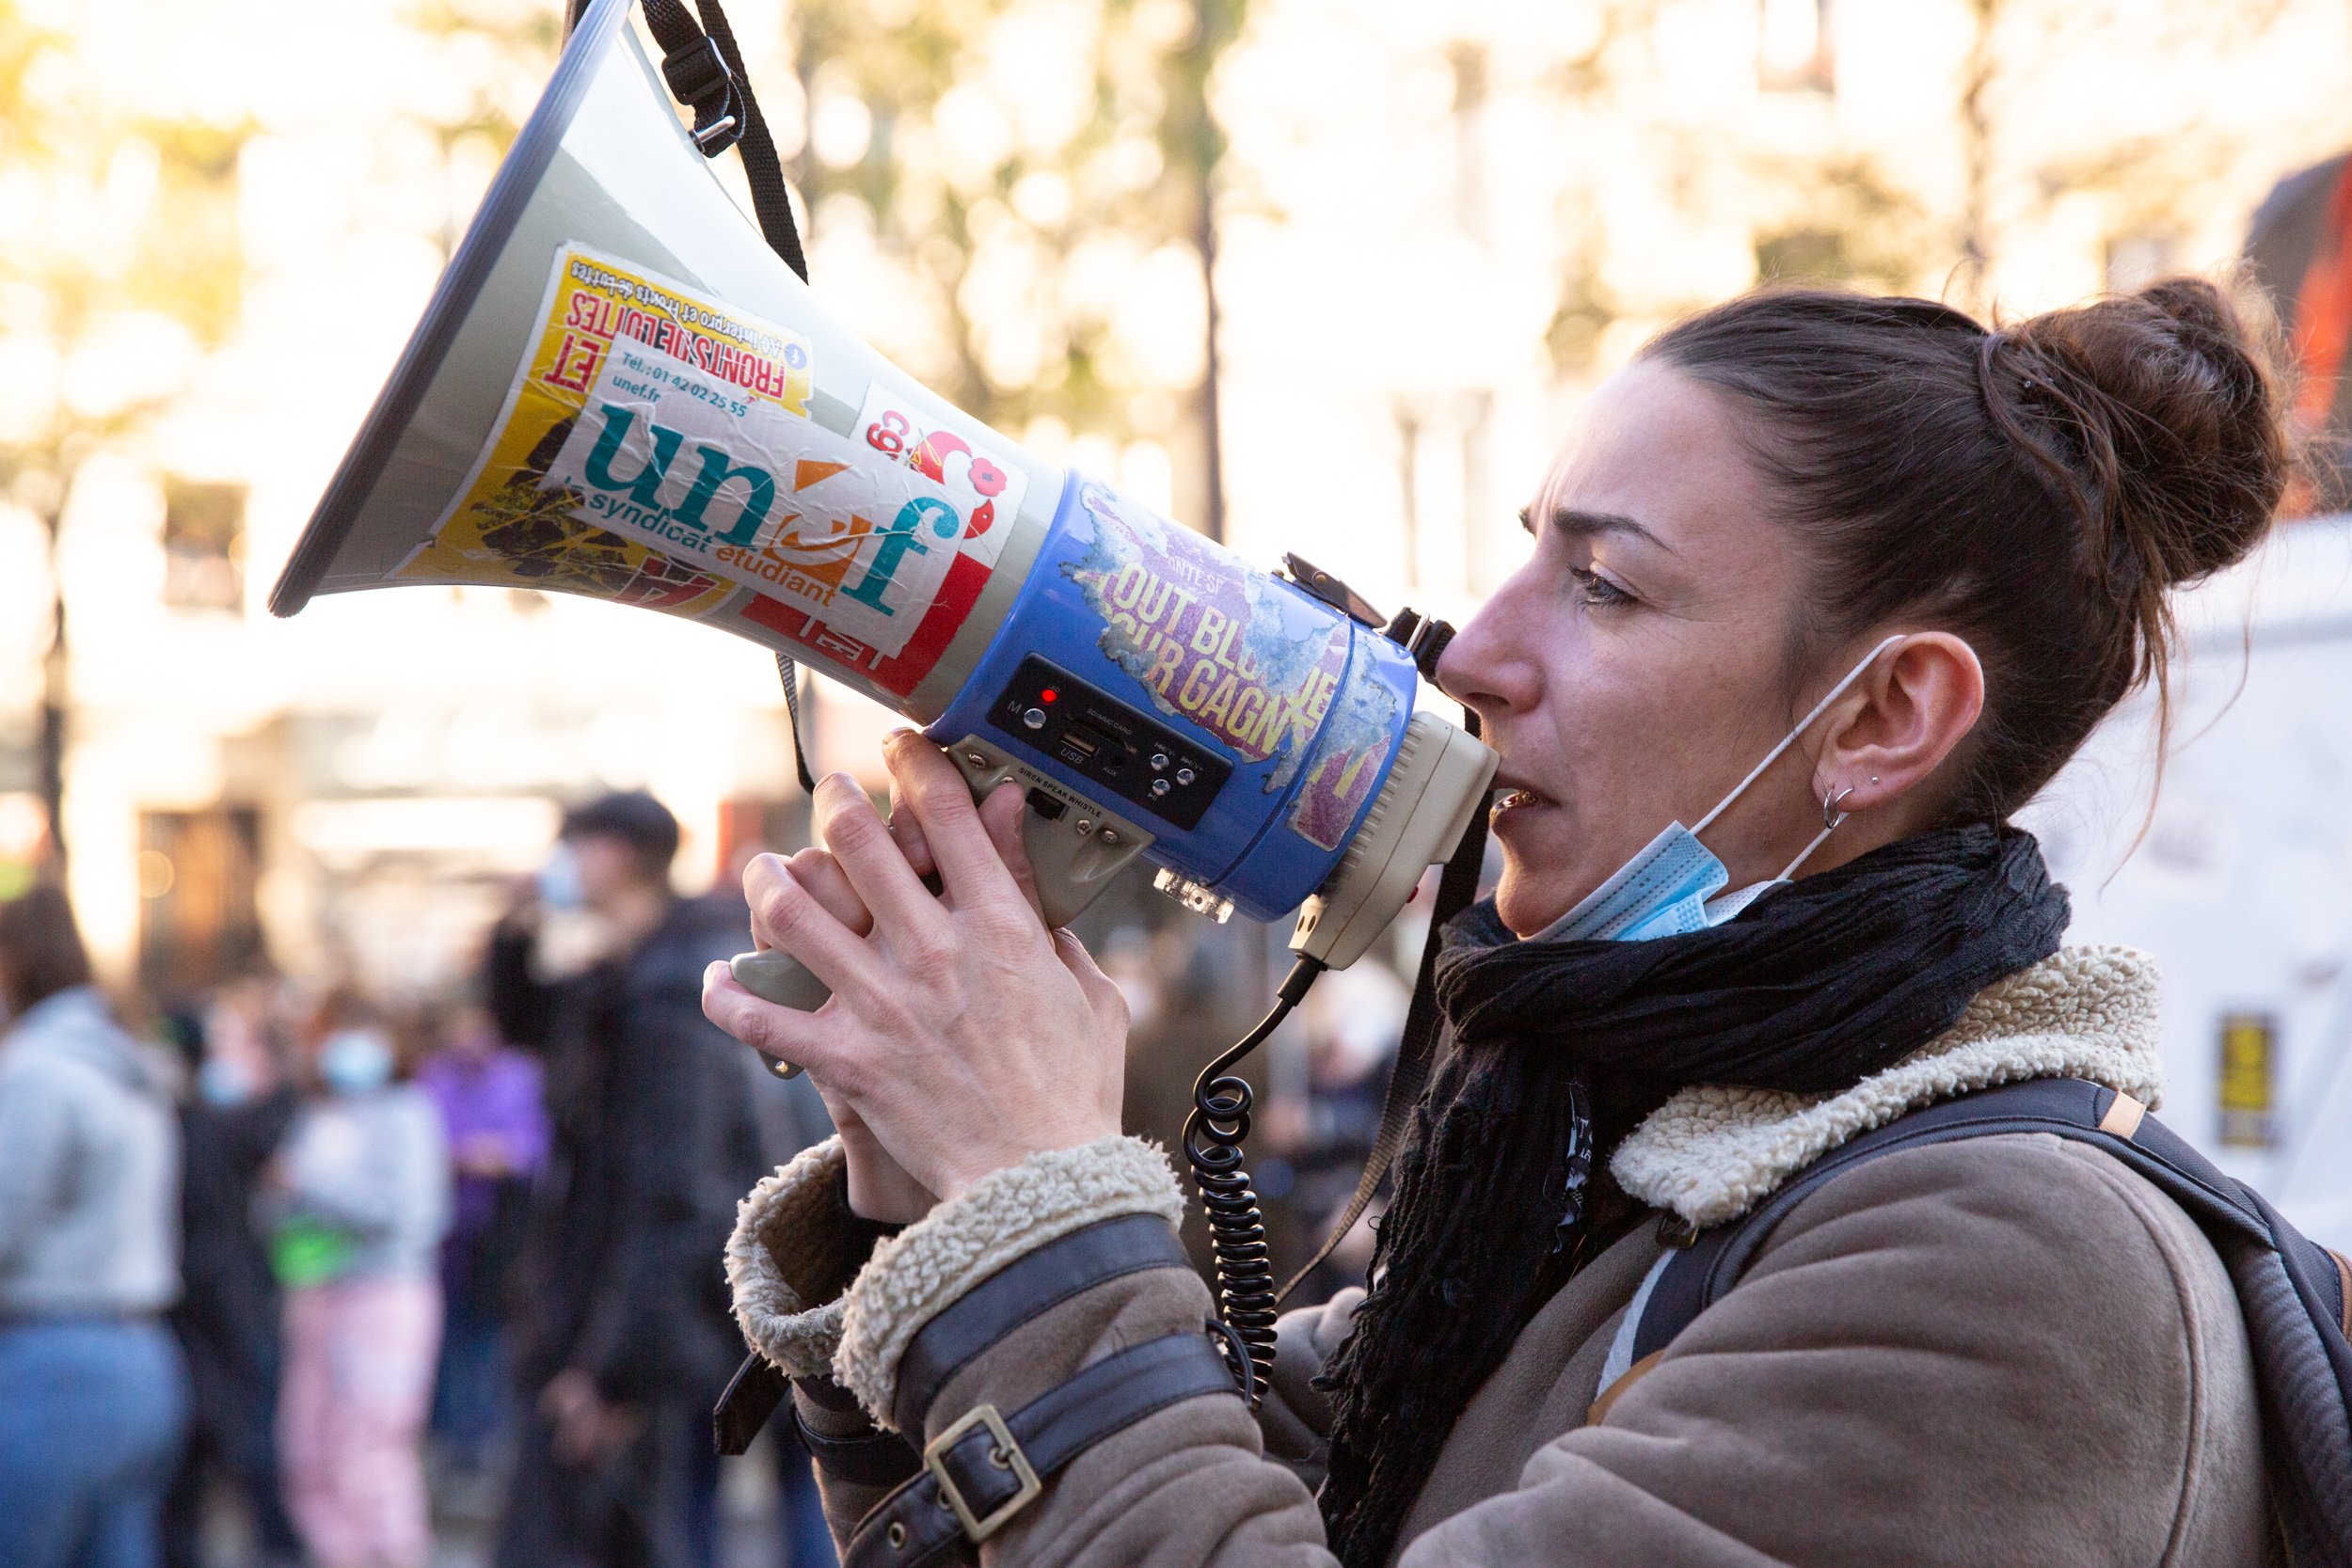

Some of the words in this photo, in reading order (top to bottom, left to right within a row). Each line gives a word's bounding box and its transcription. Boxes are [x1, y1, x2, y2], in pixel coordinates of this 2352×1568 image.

[681, 303, 699, 323] et
[542, 334, 601, 393] ET
[612, 375, 660, 403] unef.fr
[653, 366, 670, 384] 01
[672, 375, 690, 392] 42
[691, 384, 708, 400] 02
[709, 392, 727, 408] 25
[730, 401, 747, 417] 55
[589, 493, 711, 553] syndicat
[1008, 700, 1023, 715] M
[1059, 748, 1085, 766] USB
[1102, 767, 1119, 778] AUX
[1018, 767, 1042, 785] SIREN
[1042, 781, 1068, 799] SPEAK
[1068, 795, 1103, 818] WHISTLE
